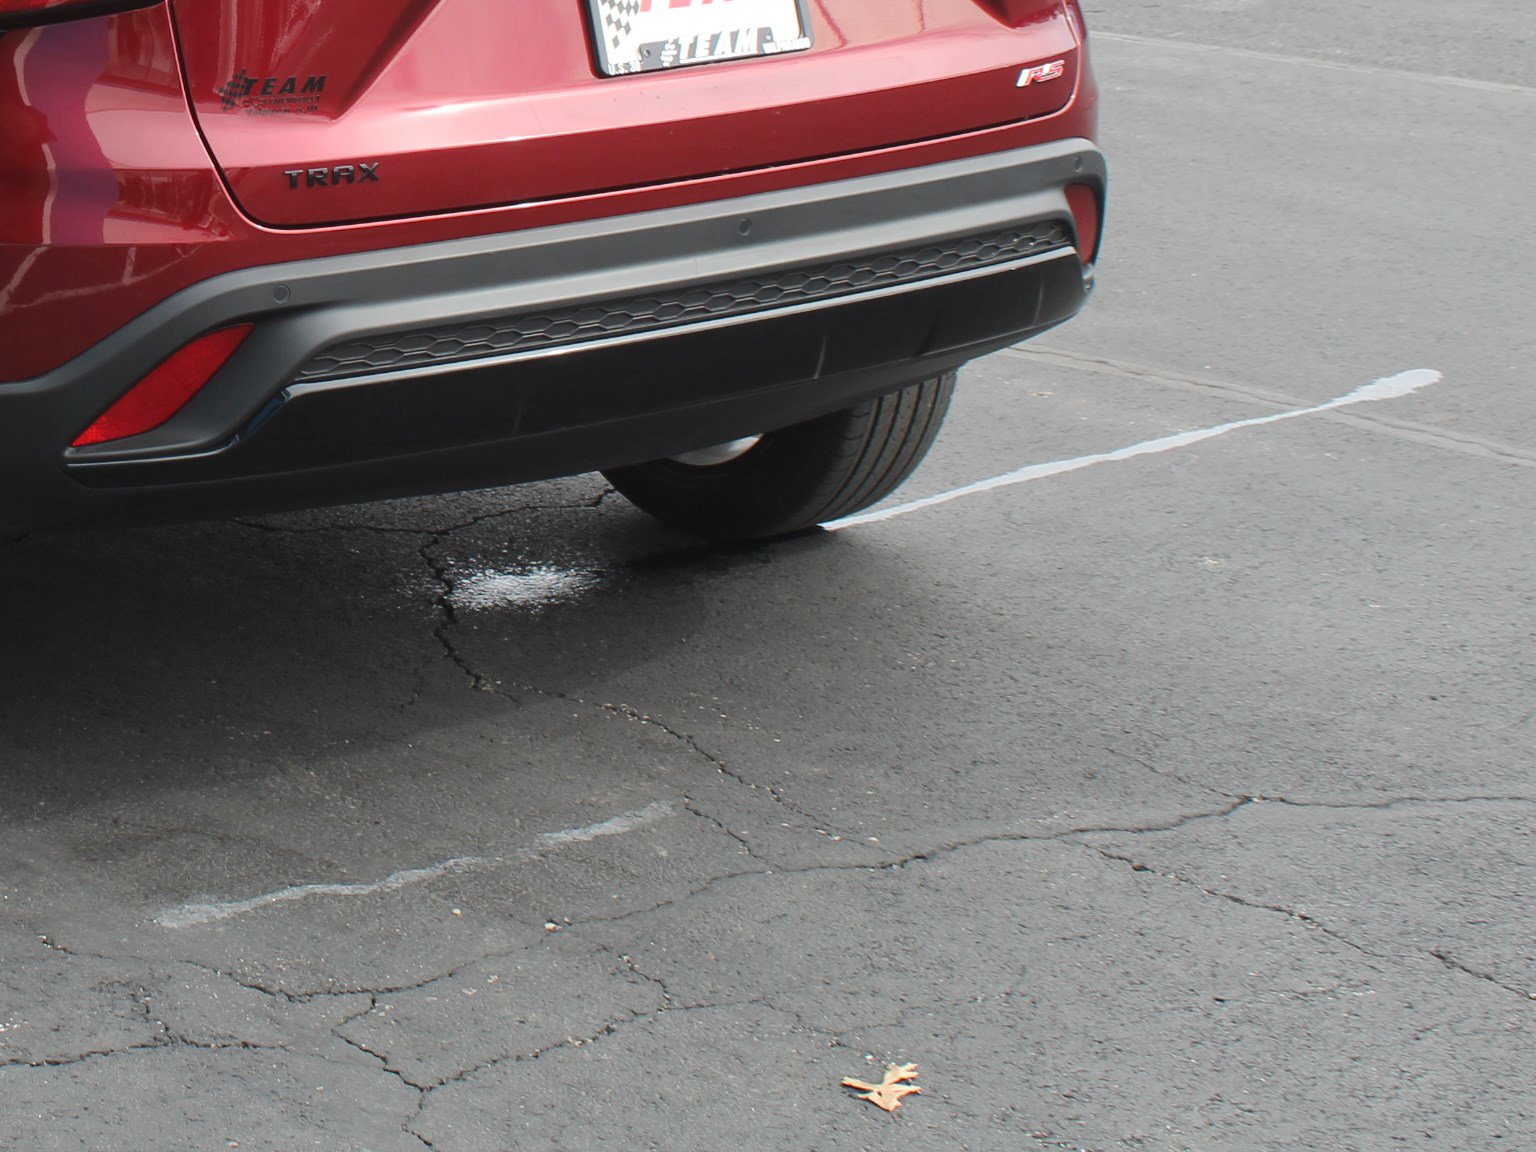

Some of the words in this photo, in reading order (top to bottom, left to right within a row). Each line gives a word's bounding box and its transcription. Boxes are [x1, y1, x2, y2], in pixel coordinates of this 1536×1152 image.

[677, 27, 759, 60] TEAM
[241, 74, 327, 96] TEAM
[1016, 59, 1065, 88] RS
[284, 162, 379, 189] TRAX
